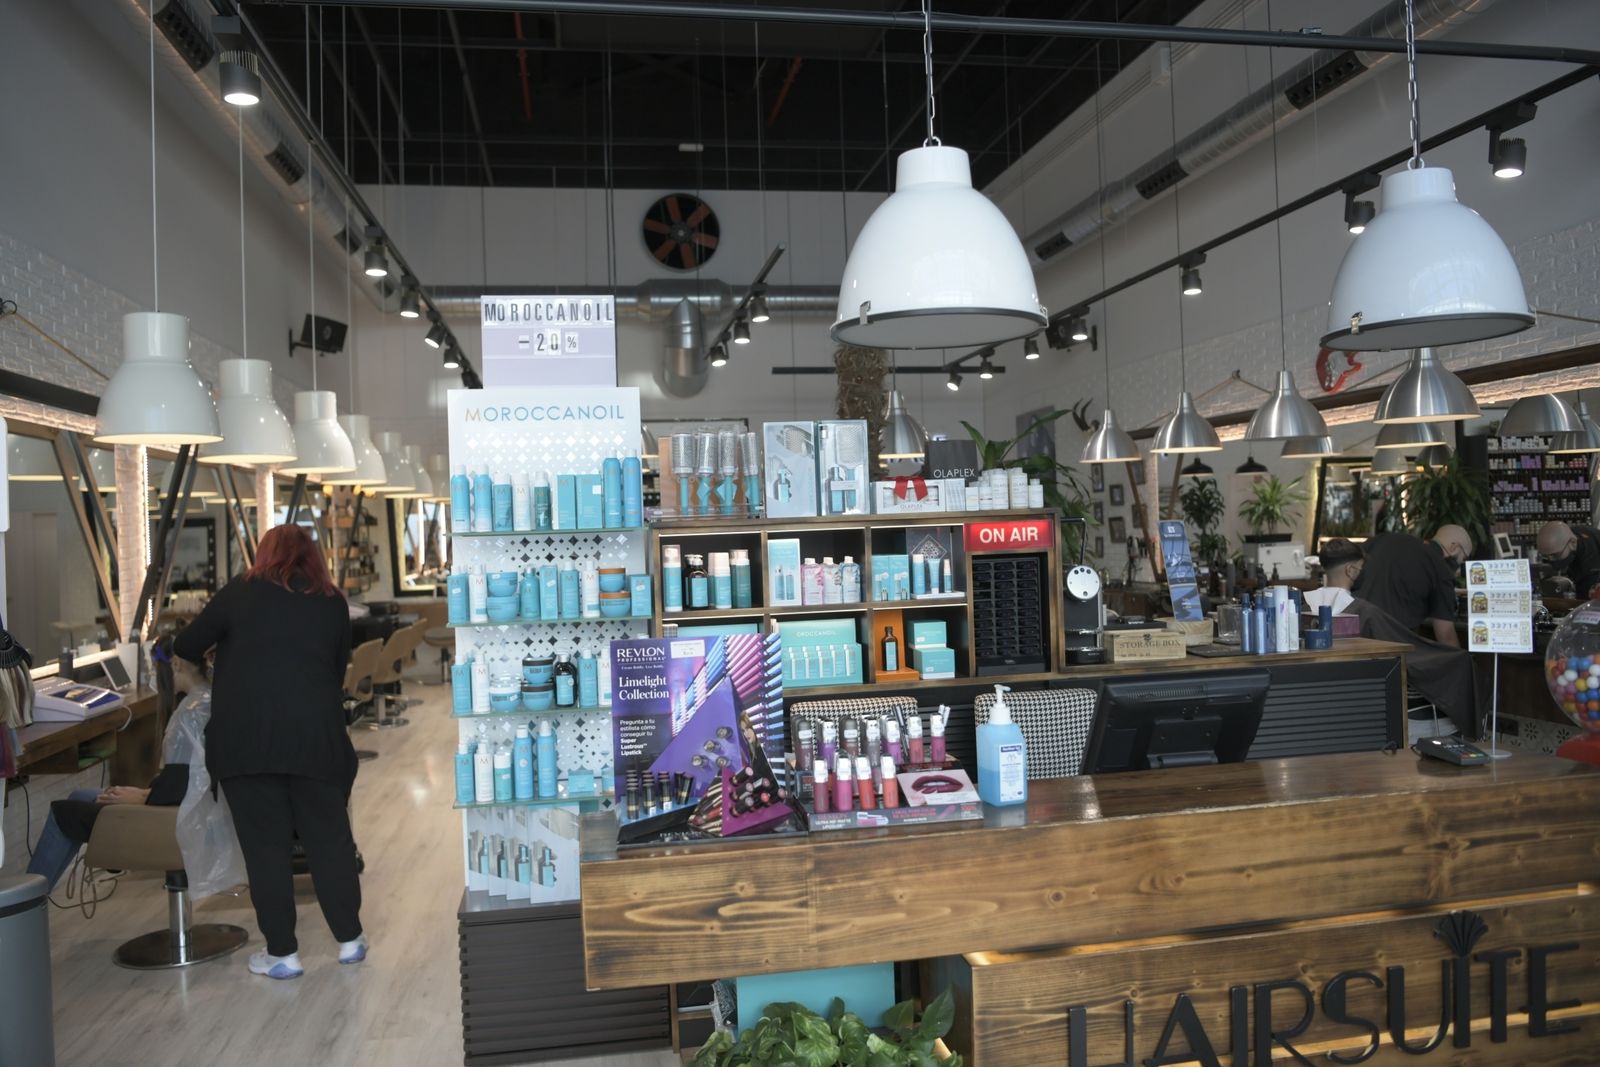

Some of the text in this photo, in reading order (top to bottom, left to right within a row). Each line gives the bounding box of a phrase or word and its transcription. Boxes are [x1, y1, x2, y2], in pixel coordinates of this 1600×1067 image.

[484, 303, 612, 322] MOROCCANOIL
[464, 405, 624, 422] MOROCCANOIL
[933, 468, 975, 478] OLAPLEX
[979, 527, 1038, 543] ON AIR
[1119, 639, 1181, 649] STORAGE BOX
[617, 646, 665, 658] REVLON
[619, 675, 667, 688] Limelight
[618, 689, 670, 700] Collection
